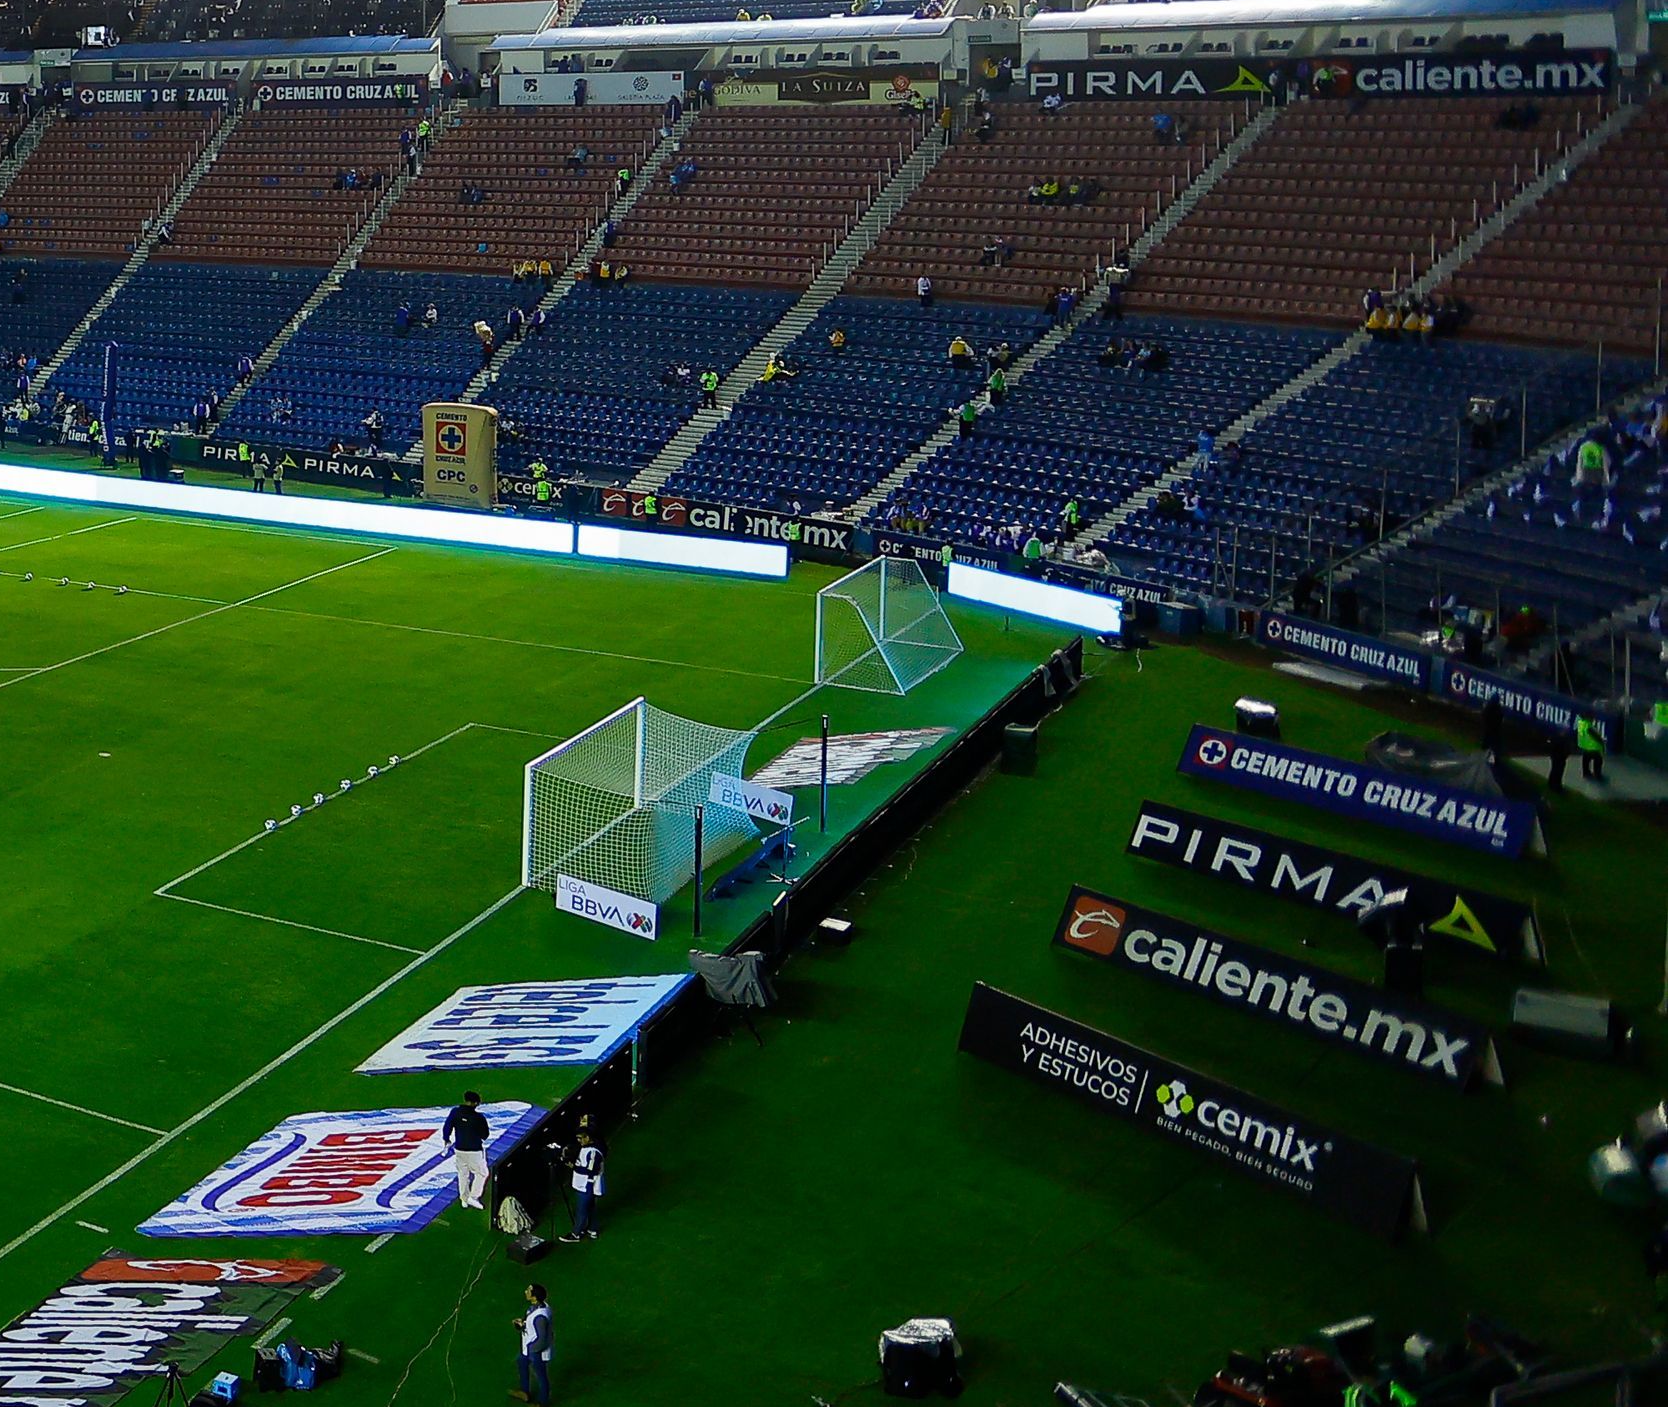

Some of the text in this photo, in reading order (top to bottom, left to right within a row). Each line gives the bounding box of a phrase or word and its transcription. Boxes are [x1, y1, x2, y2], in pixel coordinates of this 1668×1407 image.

[714, 83, 762, 96] GODIVA
[782, 79, 866, 95] LA SUIZA
[1030, 70, 1207, 96] PIRMA
[1356, 60, 1606, 92] caliente.mx
[96, 88, 229, 103] CEMENO AZUL
[275, 84, 420, 101] CEMENTO CRUZ AUL
[436, 413, 468, 422] CEMENTO
[304, 458, 375, 479] PIRMA
[437, 470, 466, 483] CPC
[514, 482, 563, 500] cex
[1283, 625, 1421, 678] CEMENTO CRUZ AZUL
[1536, 700, 1572, 729] CRUZ
[722, 788, 764, 814] BBVA
[1230, 748, 1509, 838] CEMENTO CRUZ AZUL
[1131, 812, 1390, 914] PIRMA
[559, 877, 587, 897] LIGA
[572, 894, 625, 928] BBVA
[428, 981, 657, 1031] telcel
[1123, 928, 1469, 1080] caliente.mx
[1019, 1021, 1138, 1084] ADHESIVOS
[1020, 1044, 1132, 1108] Y ESTUCOS
[1196, 1099, 1320, 1174] cemix
[236, 1128, 438, 1209] BIMBO
[1156, 1116, 1314, 1193] BIEN PEGADO, BIEN SEGURO
